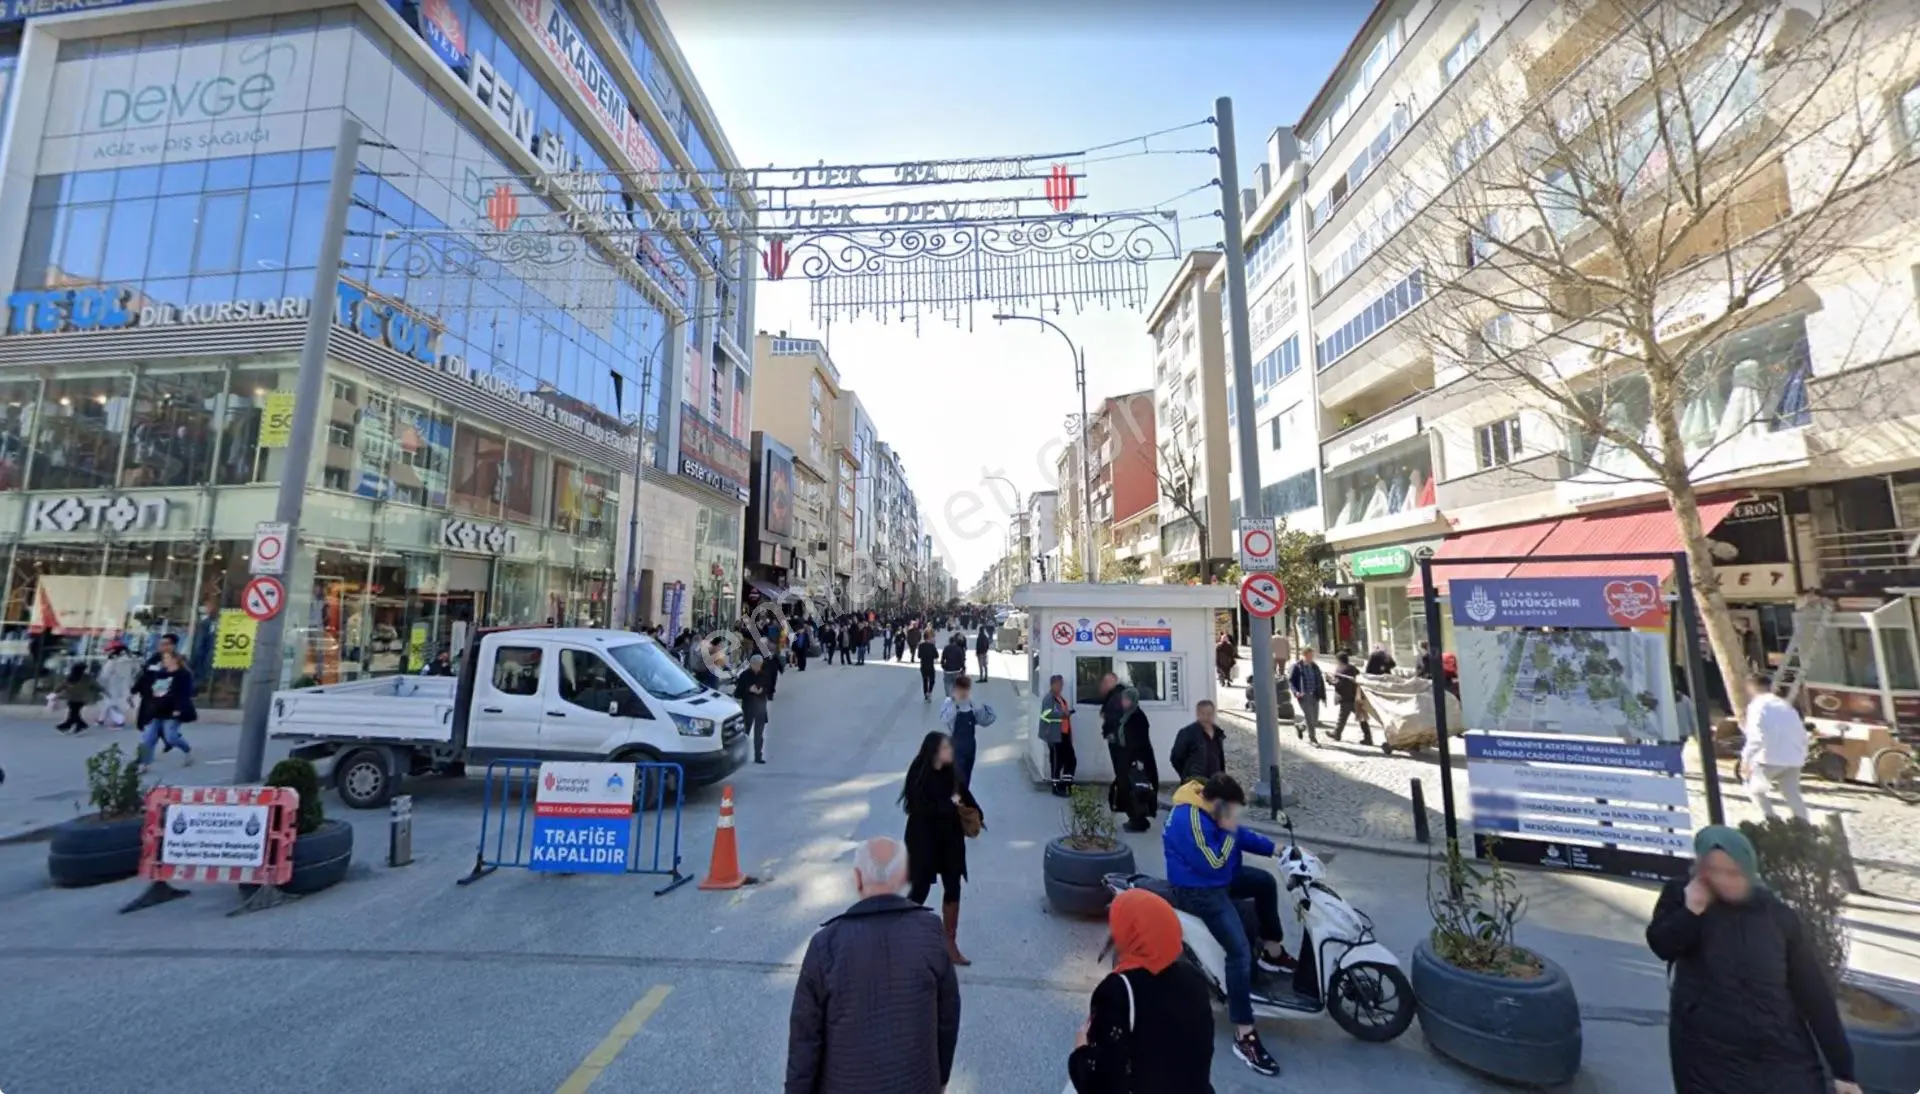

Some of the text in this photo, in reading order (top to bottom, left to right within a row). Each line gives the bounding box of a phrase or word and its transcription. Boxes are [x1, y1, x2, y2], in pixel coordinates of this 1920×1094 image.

[549, 9, 625, 132] AKADEMİ
[469, 49, 534, 151] FEN
[793, 159, 868, 188] TEK
[785, 199, 860, 228] TEK
[139, 305, 178, 327] DİL
[181, 296, 307, 323] KURSLARI
[446, 354, 473, 383] DİL
[475, 369, 545, 416] KURSLARI
[1729, 500, 1779, 520] ERON
[1713, 571, 1784, 587] LET
[1501, 596, 1581, 610] BÜYÜKŞEHİR
[223, 633, 251, 650] 50
[1482, 748, 1525, 758] ALEMDAĞ
[545, 827, 617, 847] TRAFİĞE
[533, 845, 625, 864] KAPALIDIR
